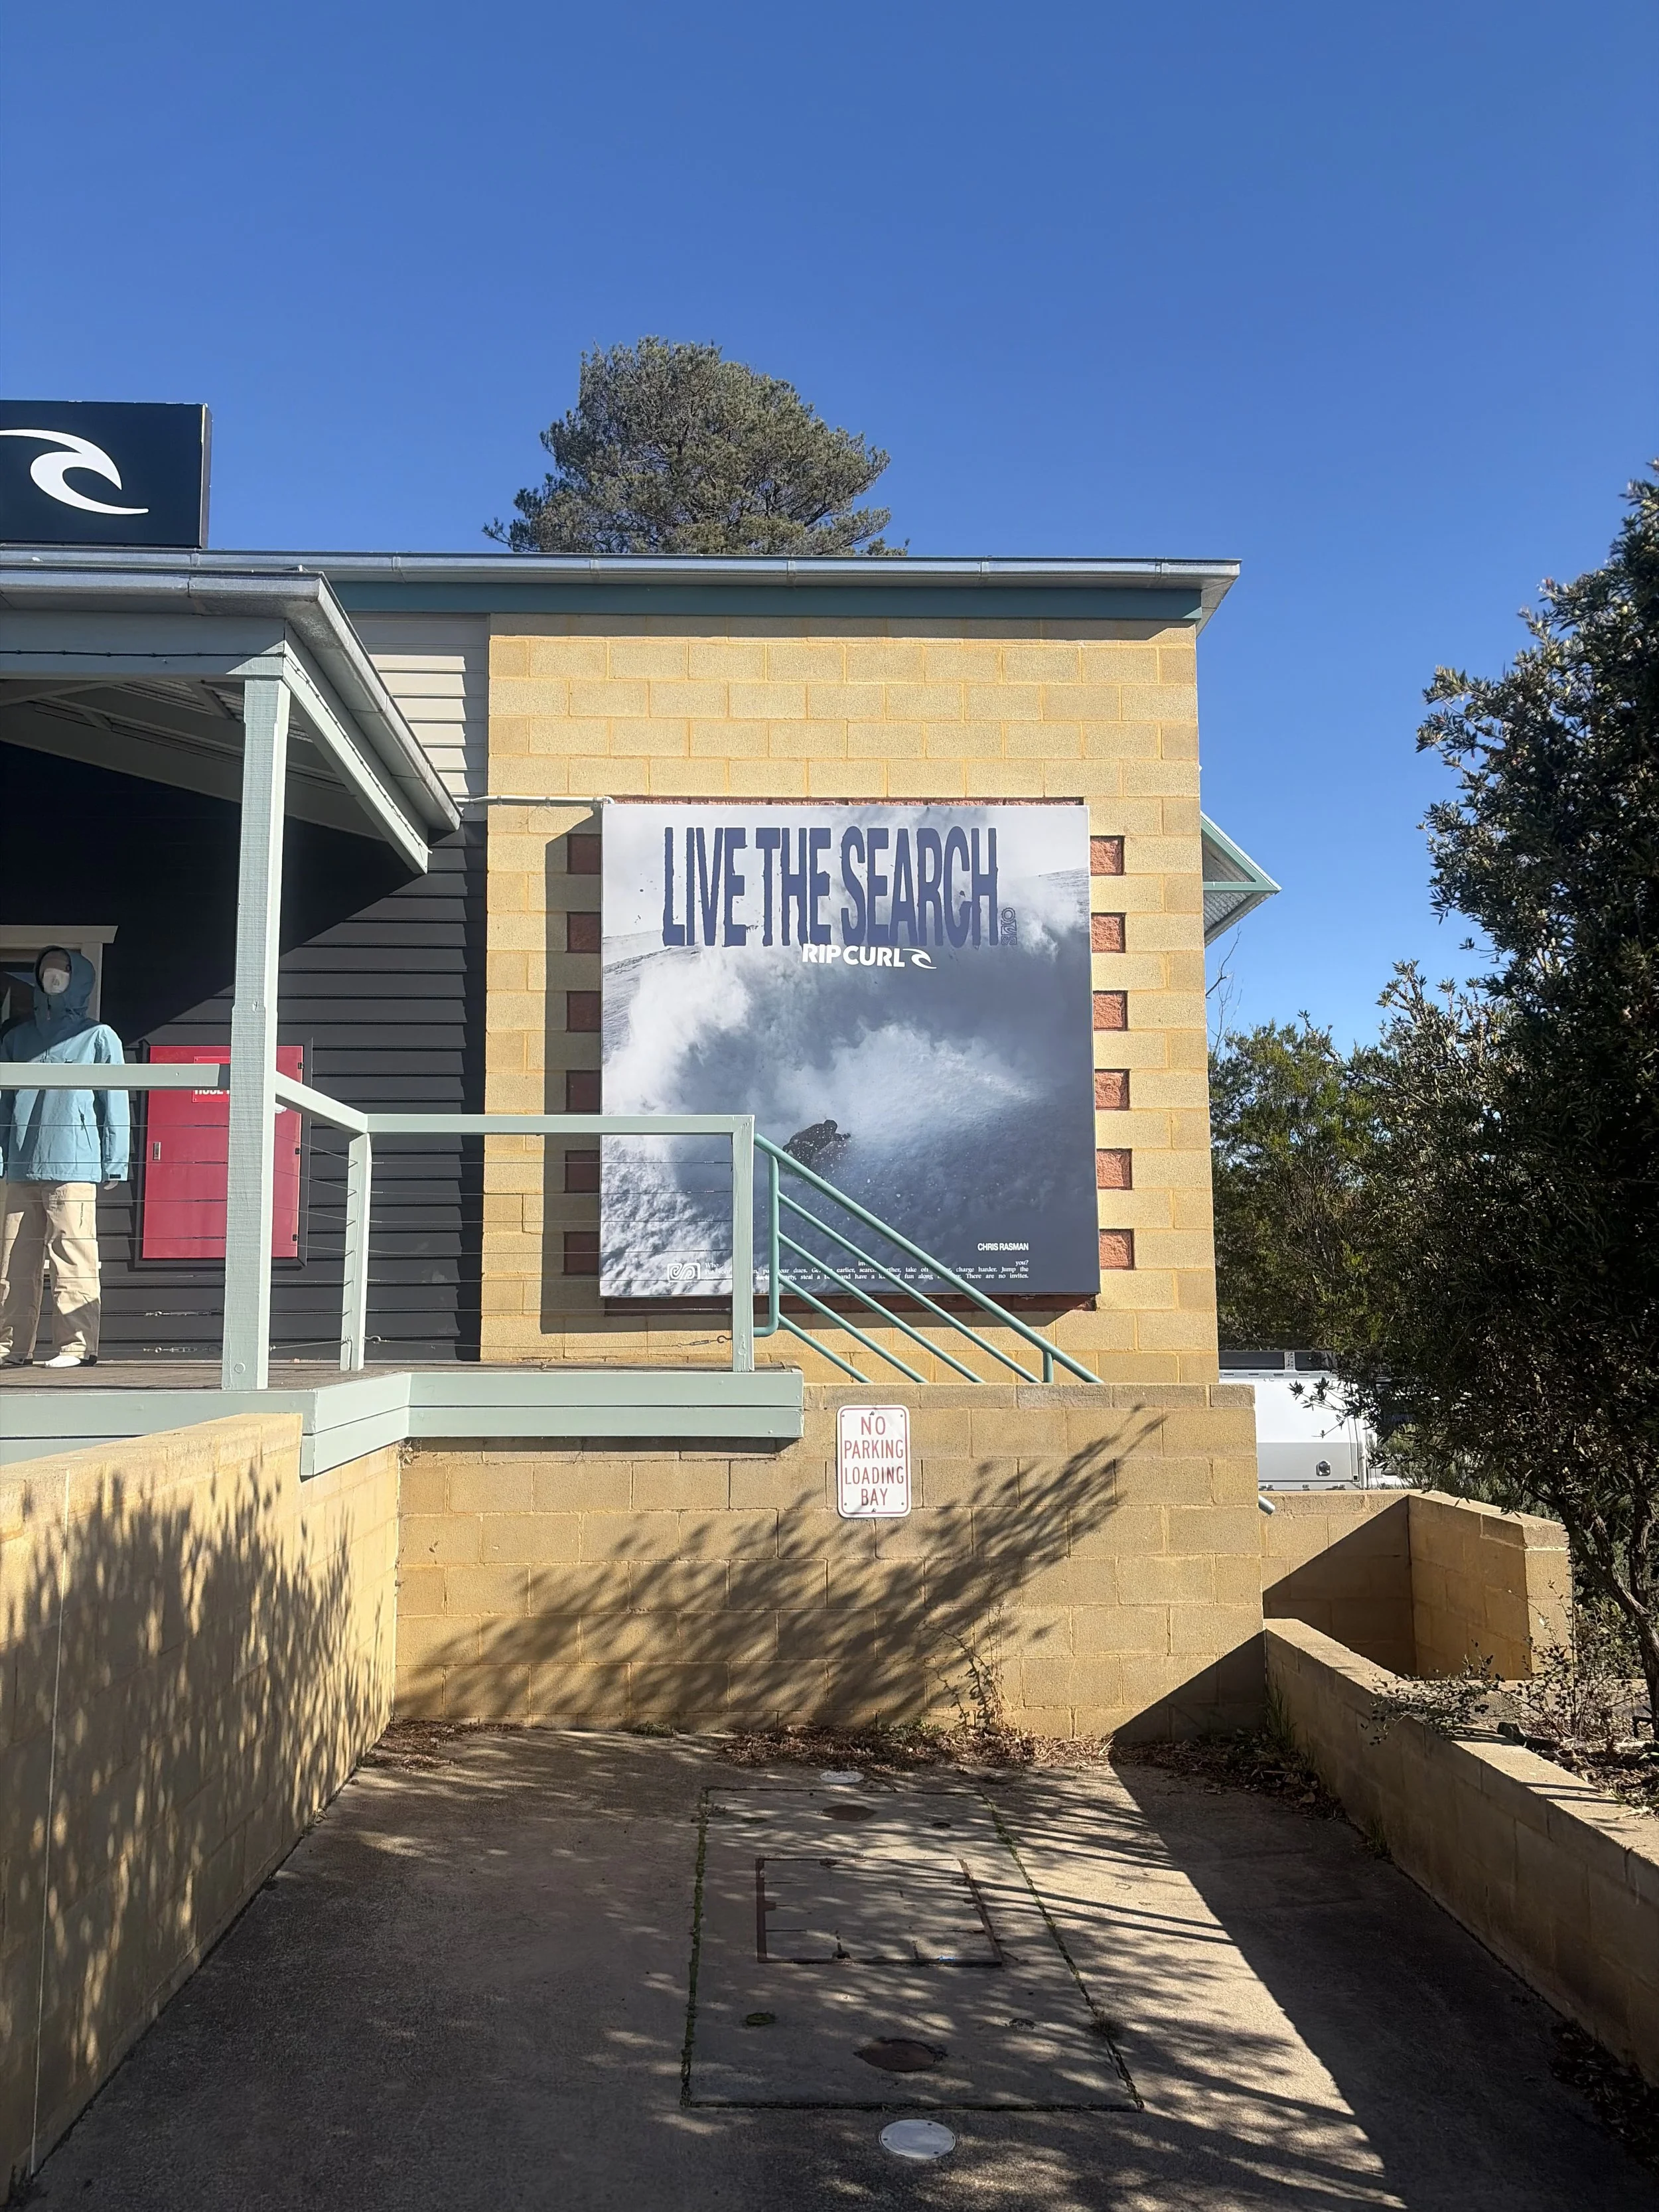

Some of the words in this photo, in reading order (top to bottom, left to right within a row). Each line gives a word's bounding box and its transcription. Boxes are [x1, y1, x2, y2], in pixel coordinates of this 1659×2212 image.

[662, 827, 748, 947] LIVE
[755, 827, 831, 947] THE
[840, 826, 999, 948] SEARCH
[977, 1242, 999, 1251] CHRIS
[999, 1242, 1029, 1251] RASMAN
[861, 1416, 886, 1436] NO
[844, 1439, 904, 1459] PARKING
[845, 1466, 904, 1485] LOADING
[861, 1488, 888, 1506] BAY
